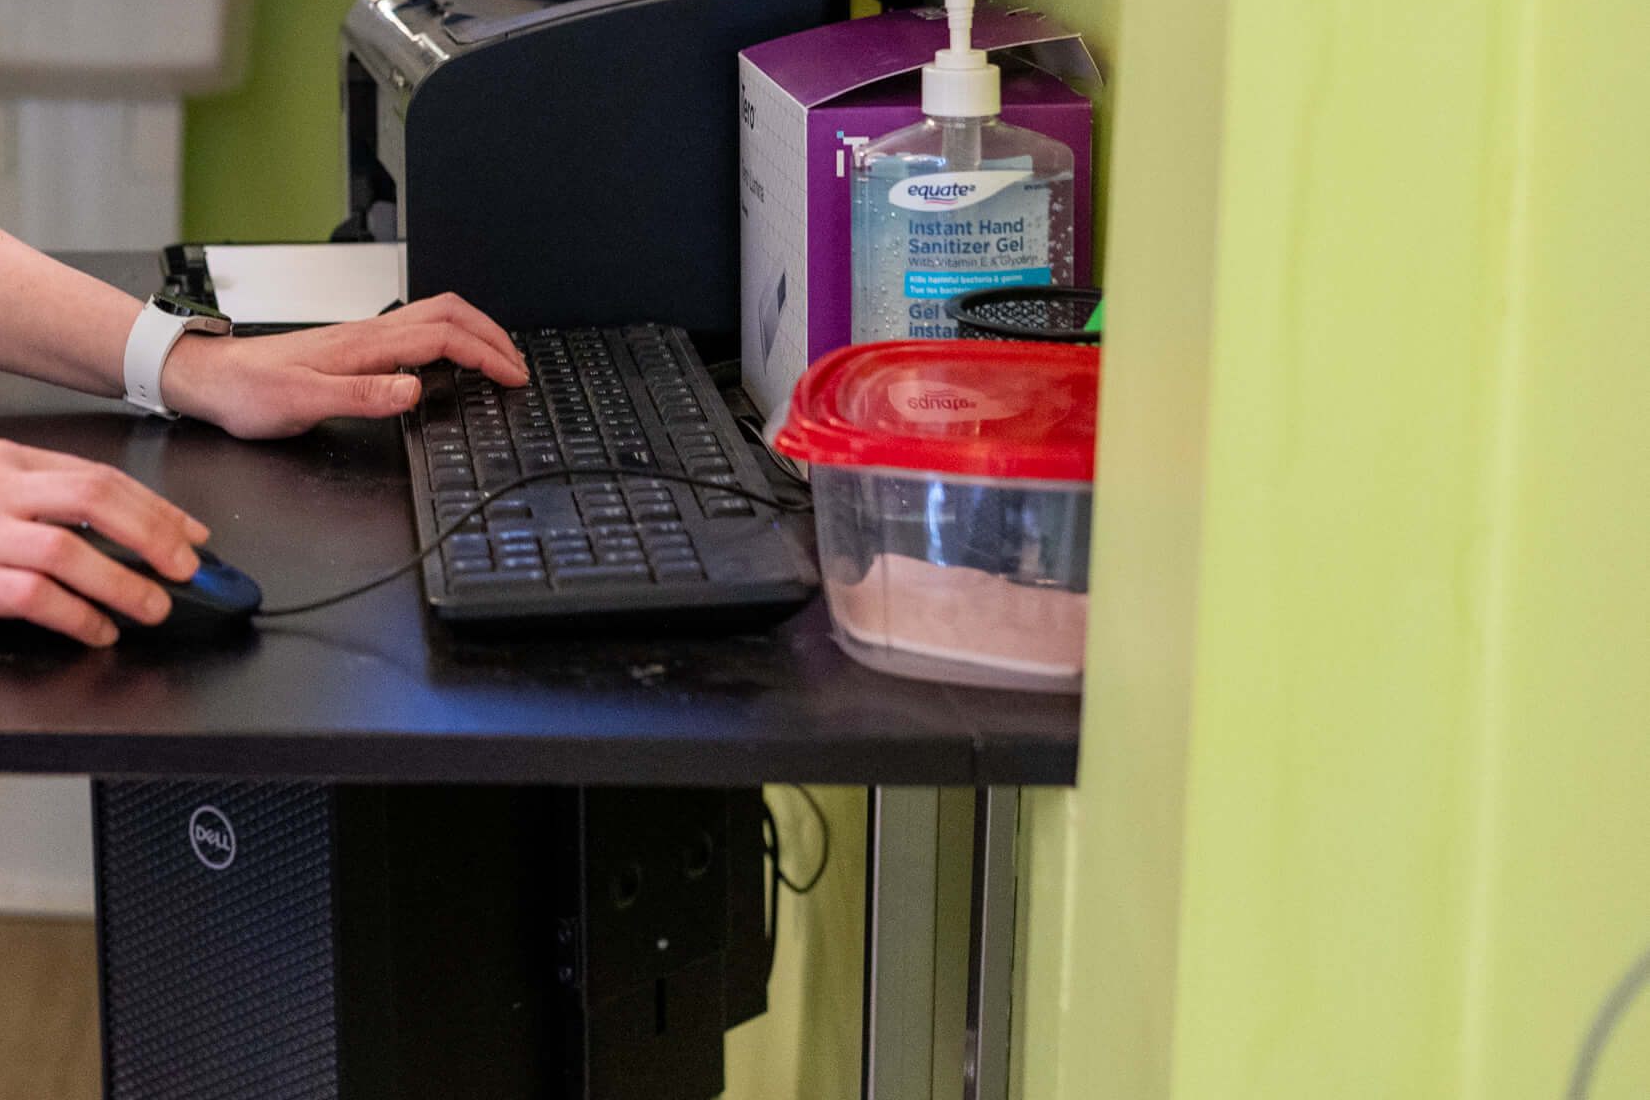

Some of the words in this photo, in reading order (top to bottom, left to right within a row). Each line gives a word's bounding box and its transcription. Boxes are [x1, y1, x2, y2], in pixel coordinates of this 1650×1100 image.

[907, 182, 968, 200] equate
[908, 219, 973, 235] Instant
[979, 216, 1024, 234] Hand
[908, 238, 991, 254] Sanitizer
[996, 236, 1024, 253] Gel
[927, 275, 959, 284] harmful
[960, 275, 992, 285] bacteria
[908, 304, 940, 320] Gel
[195, 823, 232, 852] DELL
